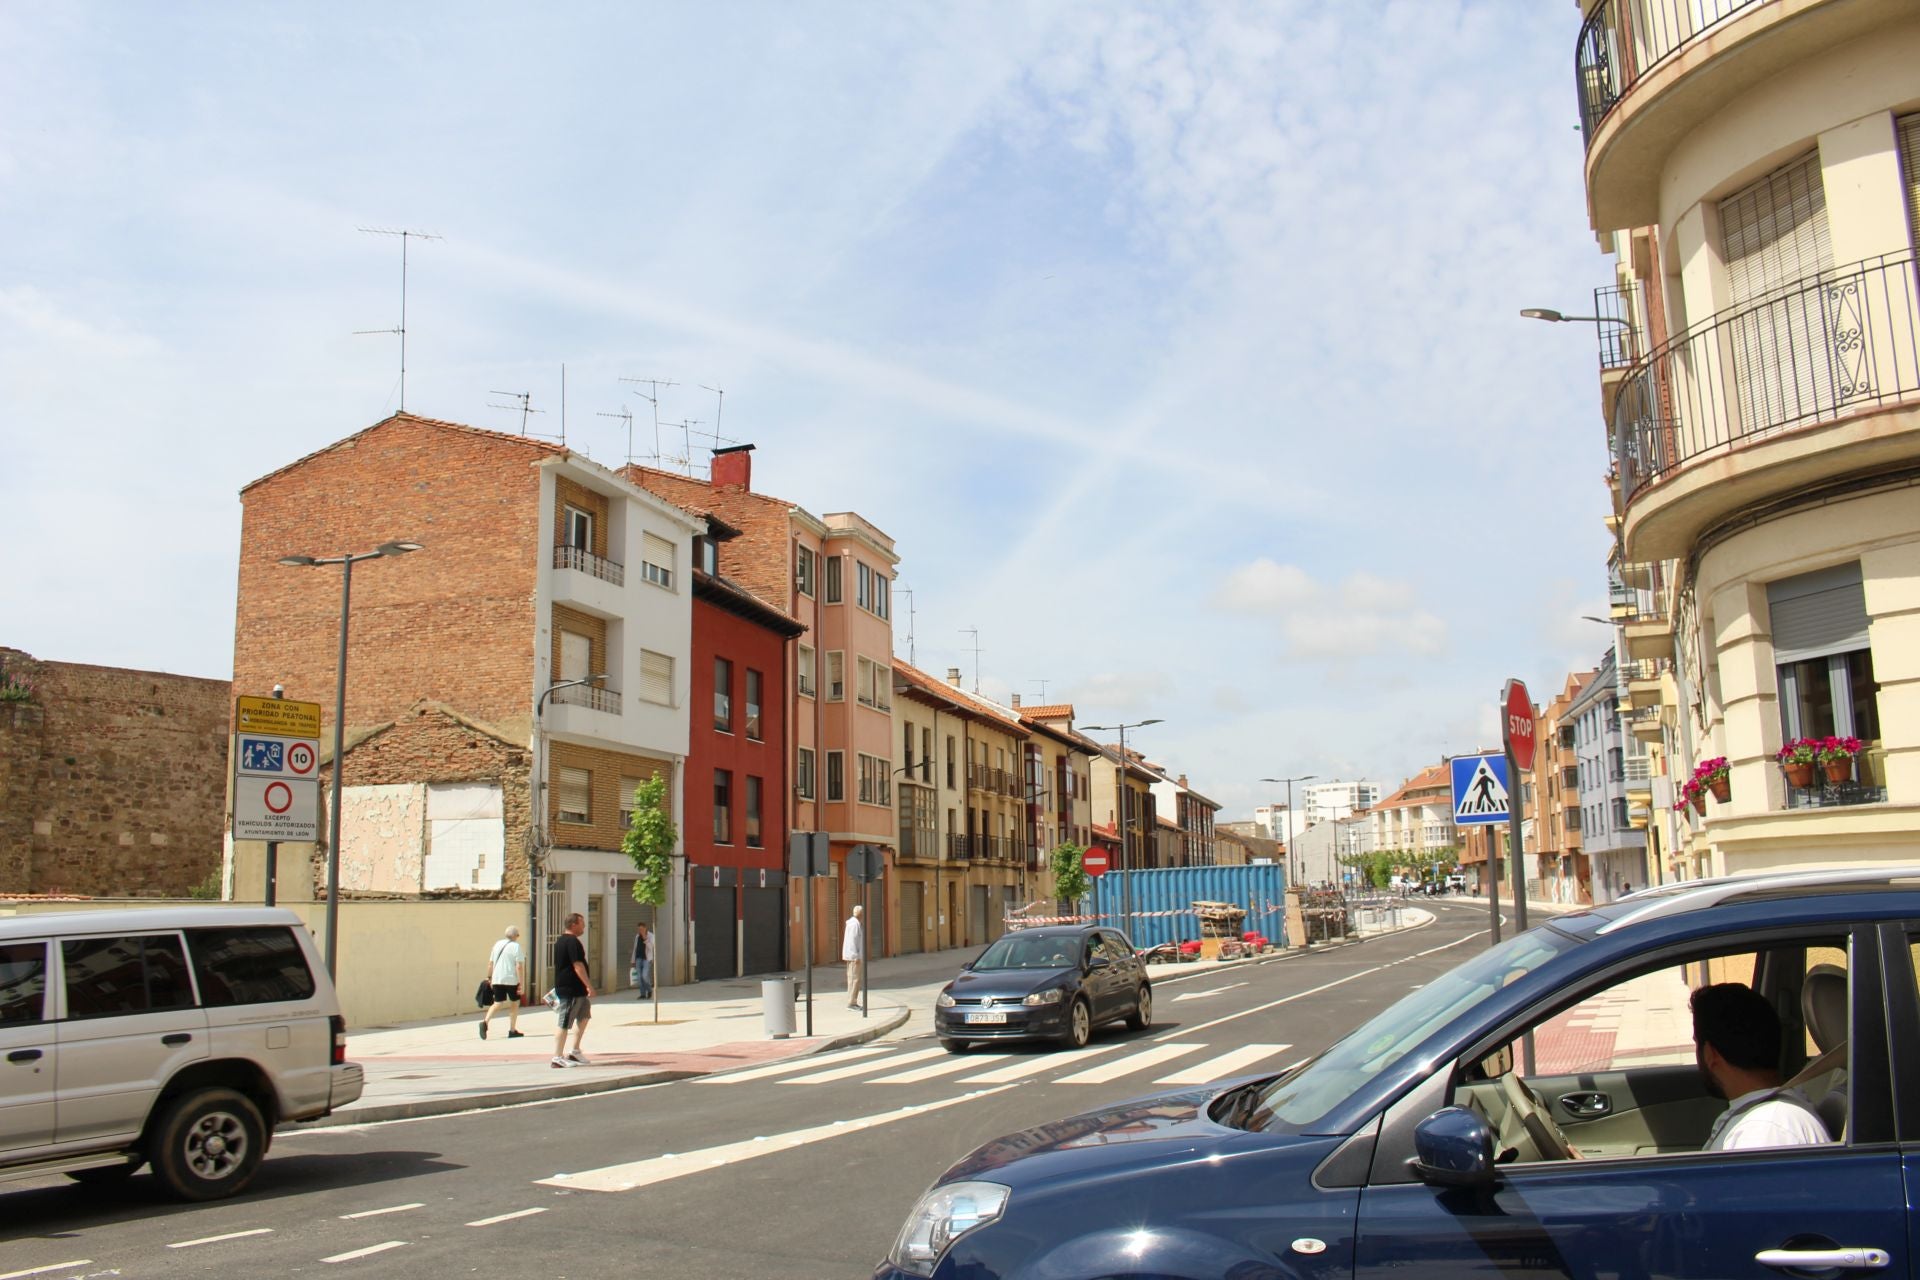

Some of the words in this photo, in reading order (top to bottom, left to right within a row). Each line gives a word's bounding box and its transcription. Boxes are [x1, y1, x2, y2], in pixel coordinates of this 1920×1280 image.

[262, 702, 280, 710] ZONA
[242, 708, 279, 717] PRIORIDAD
[282, 712, 316, 721] PEATONAL
[1510, 715, 1532, 738] STOP
[294, 753, 308, 764] 10
